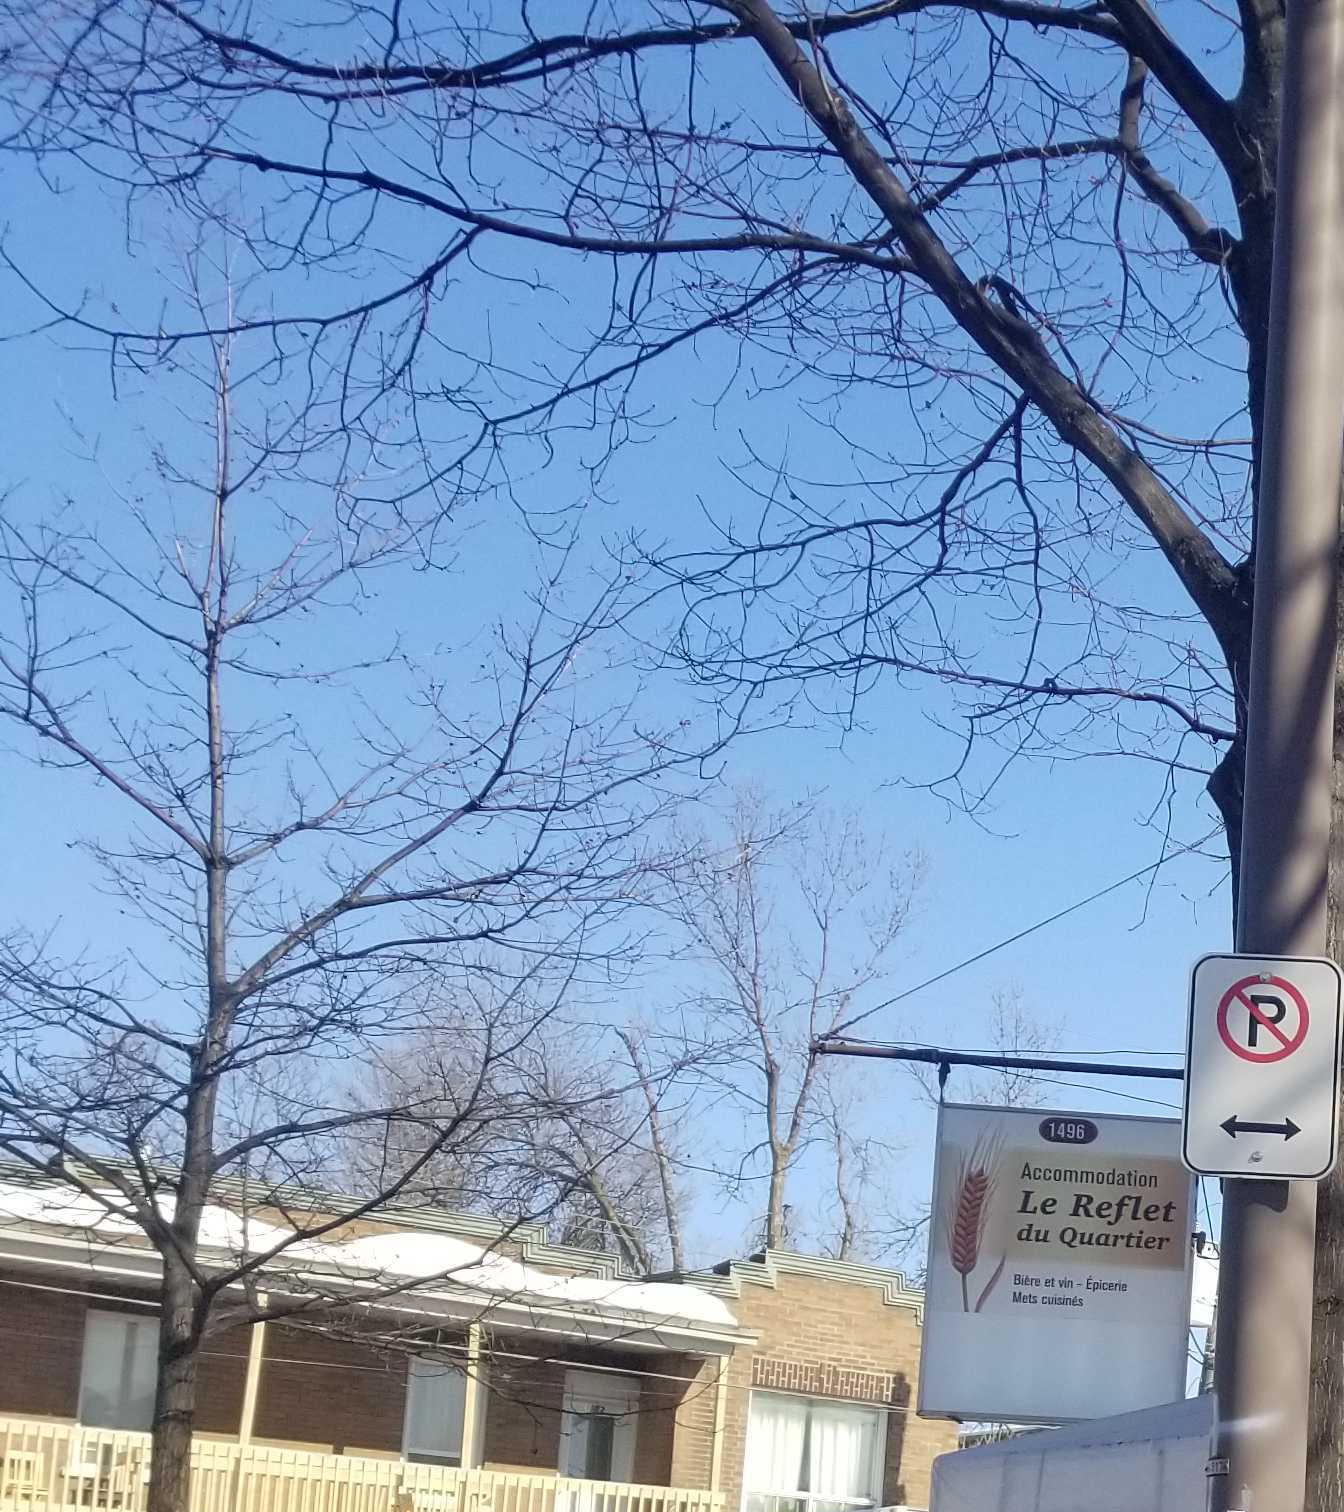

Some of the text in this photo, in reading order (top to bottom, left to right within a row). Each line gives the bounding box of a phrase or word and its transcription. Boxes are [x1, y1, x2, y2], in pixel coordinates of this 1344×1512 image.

[1049, 1122, 1086, 1140] 1496
[1020, 1161, 1158, 1188] Accommodation
[1017, 1190, 1177, 1226] Le Reflet
[1016, 1223, 1171, 1250] du Quartier
[1013, 1273, 1041, 1287] Bière
[1044, 1277, 1056, 1288] et
[1058, 1276, 1074, 1288] vin
[1086, 1275, 1128, 1292] Épicerie
[1012, 1291, 1085, 1307] Mets cuisinés
